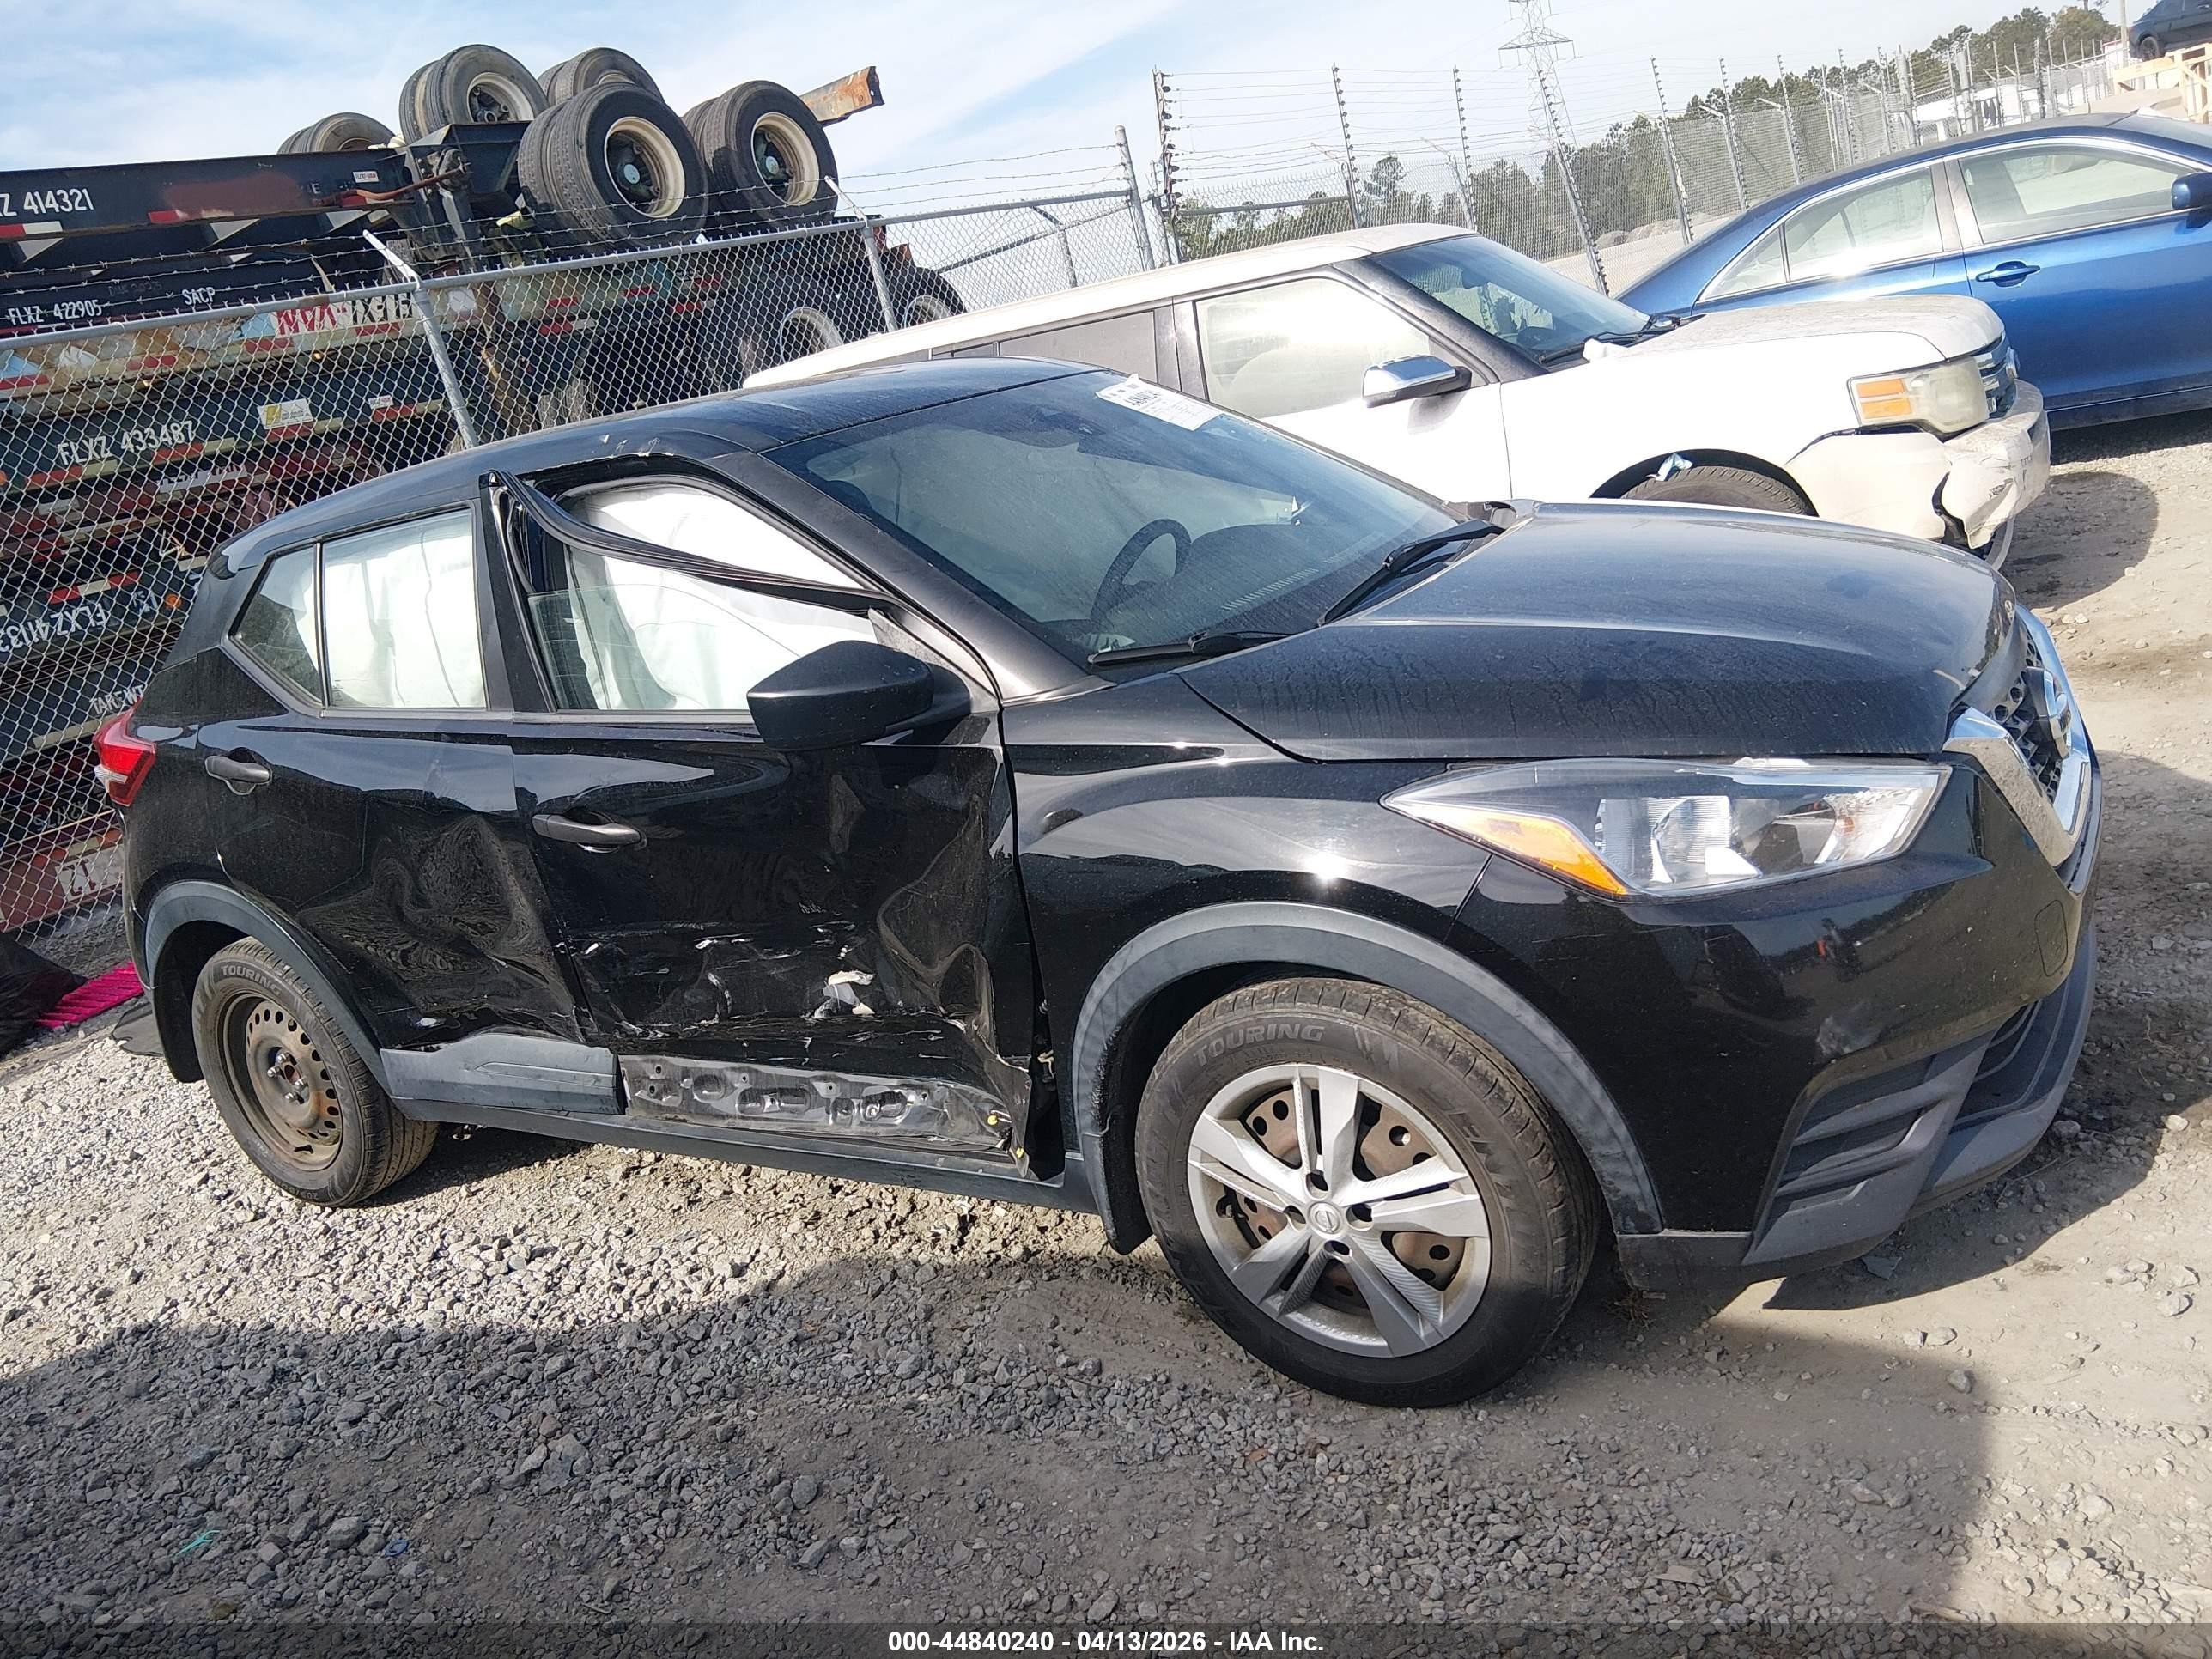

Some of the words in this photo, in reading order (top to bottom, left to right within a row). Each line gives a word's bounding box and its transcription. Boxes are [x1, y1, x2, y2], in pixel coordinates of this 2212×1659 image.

[23, 188, 94, 215] 414321
[8, 306, 45, 325] FLXZ
[52, 300, 103, 320] 422905
[181, 286, 216, 306] SACP
[58, 436, 112, 466] FLXZ
[120, 420, 196, 453] 433487
[51, 603, 107, 636] FLXZ
[221, 963, 283, 996] TOURING
[1193, 1022, 1326, 1066] TOURING
